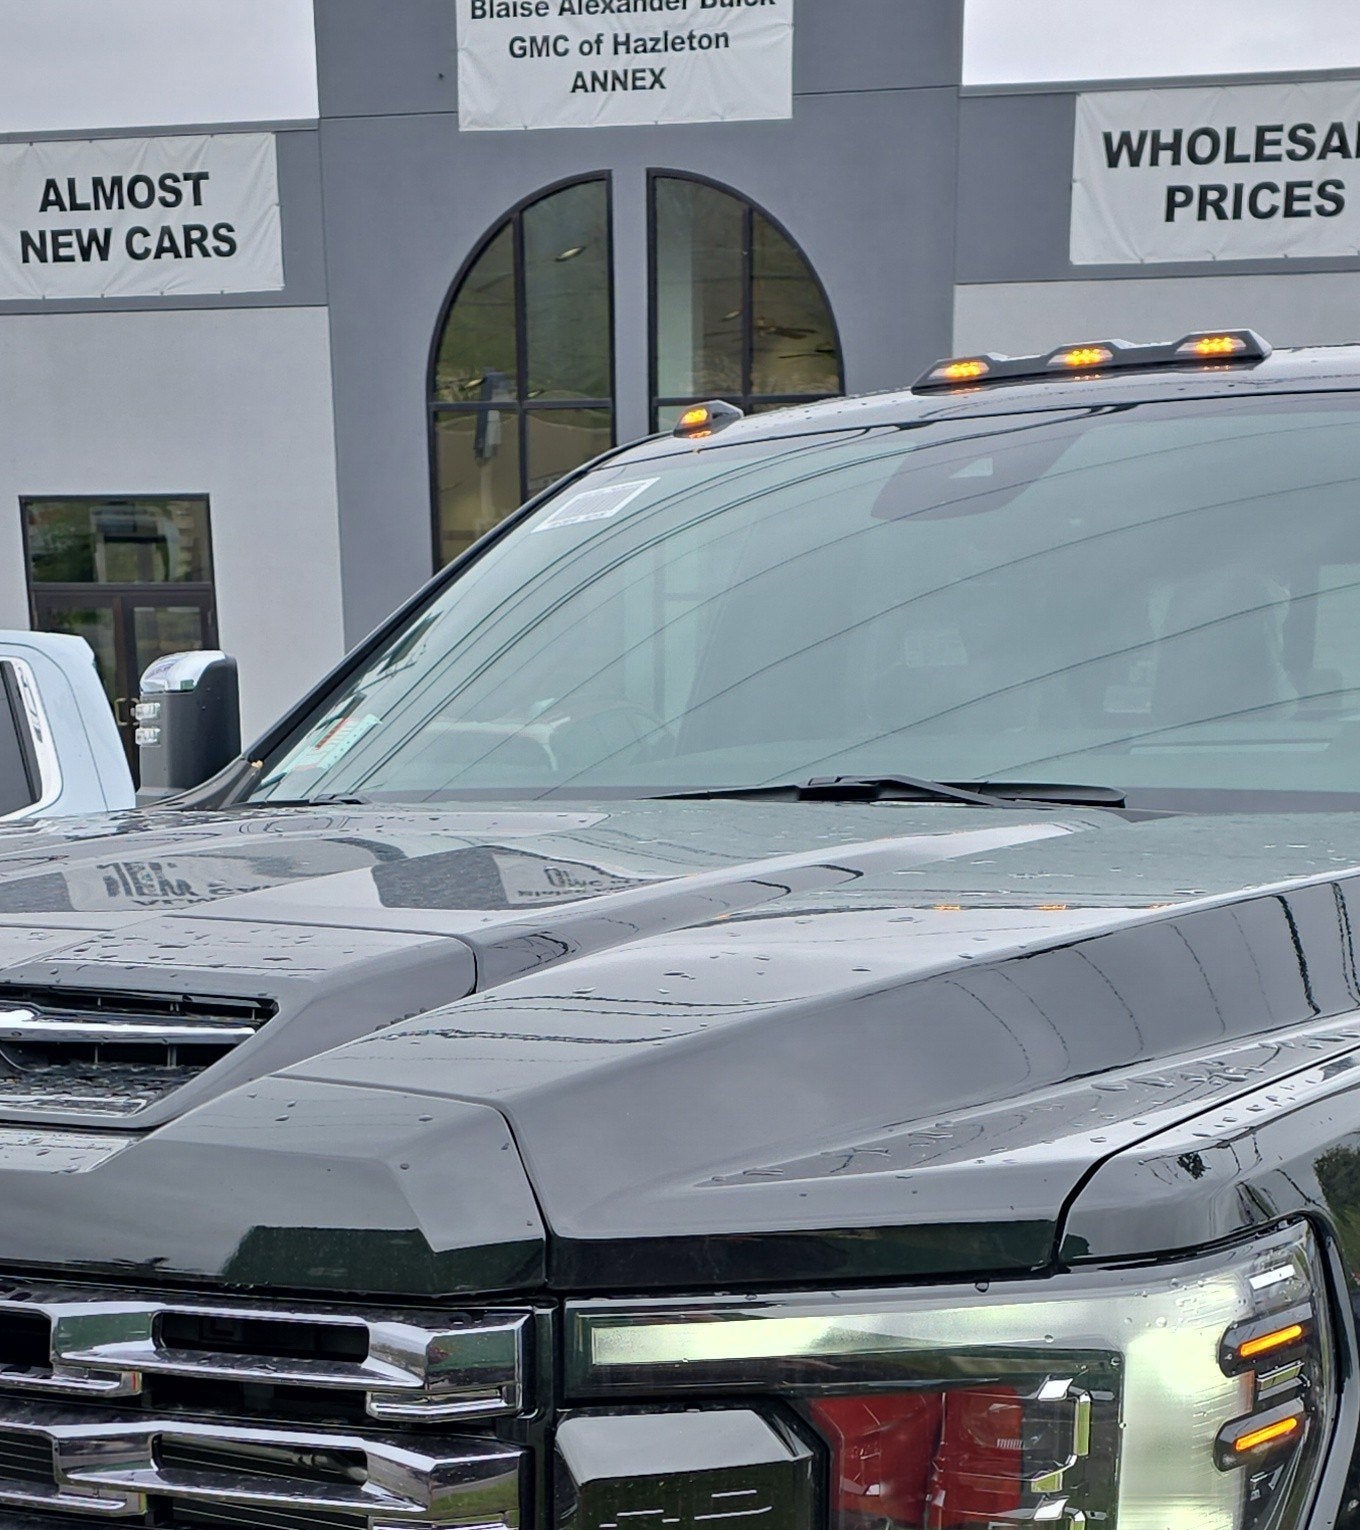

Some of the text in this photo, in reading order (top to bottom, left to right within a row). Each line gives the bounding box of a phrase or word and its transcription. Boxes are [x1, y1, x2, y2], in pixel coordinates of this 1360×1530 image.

[470, 0, 550, 19] Blaise
[508, 29, 730, 58] GMC of Hazleton
[569, 67, 667, 93] ANNEX
[38, 171, 210, 212] ALMOST
[1164, 178, 1347, 223] PRICES
[19, 222, 238, 264] NEW CARS
